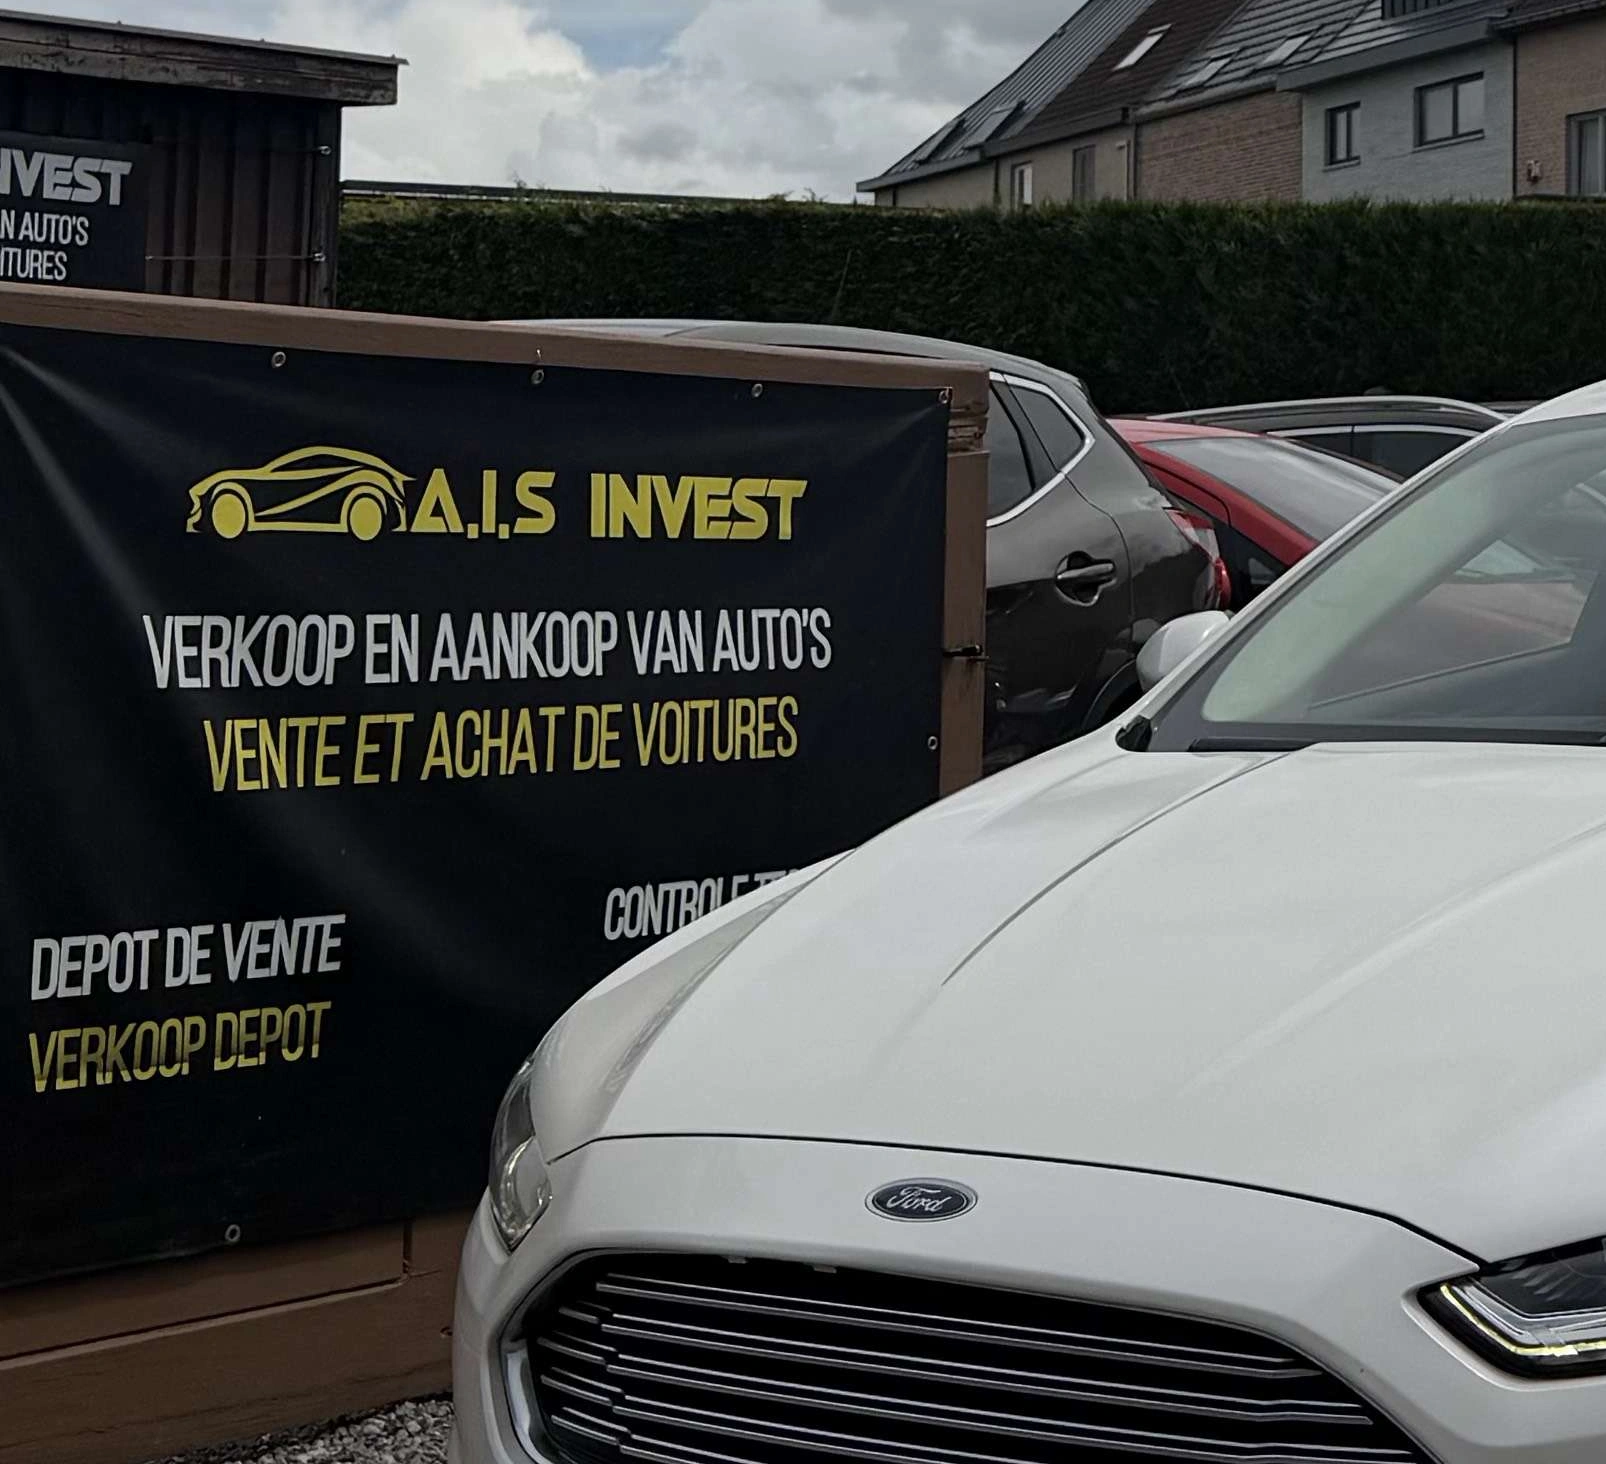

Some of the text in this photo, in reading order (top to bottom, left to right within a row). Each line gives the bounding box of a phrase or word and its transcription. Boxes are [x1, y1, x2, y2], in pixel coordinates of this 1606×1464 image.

[18, 211, 89, 246] AUTO'S
[410, 468, 808, 540] A.I.S INVEST
[142, 607, 832, 689] VERKOOP EN AANKOOP VAN AUTO'S
[202, 695, 799, 792] VENTE ET ACHAT DE VOITURES
[31, 913, 347, 1001] DEPOT DE VENTE
[28, 1000, 332, 1093] VERKOOP DEPOT
[886, 1186, 952, 1213] Ford
